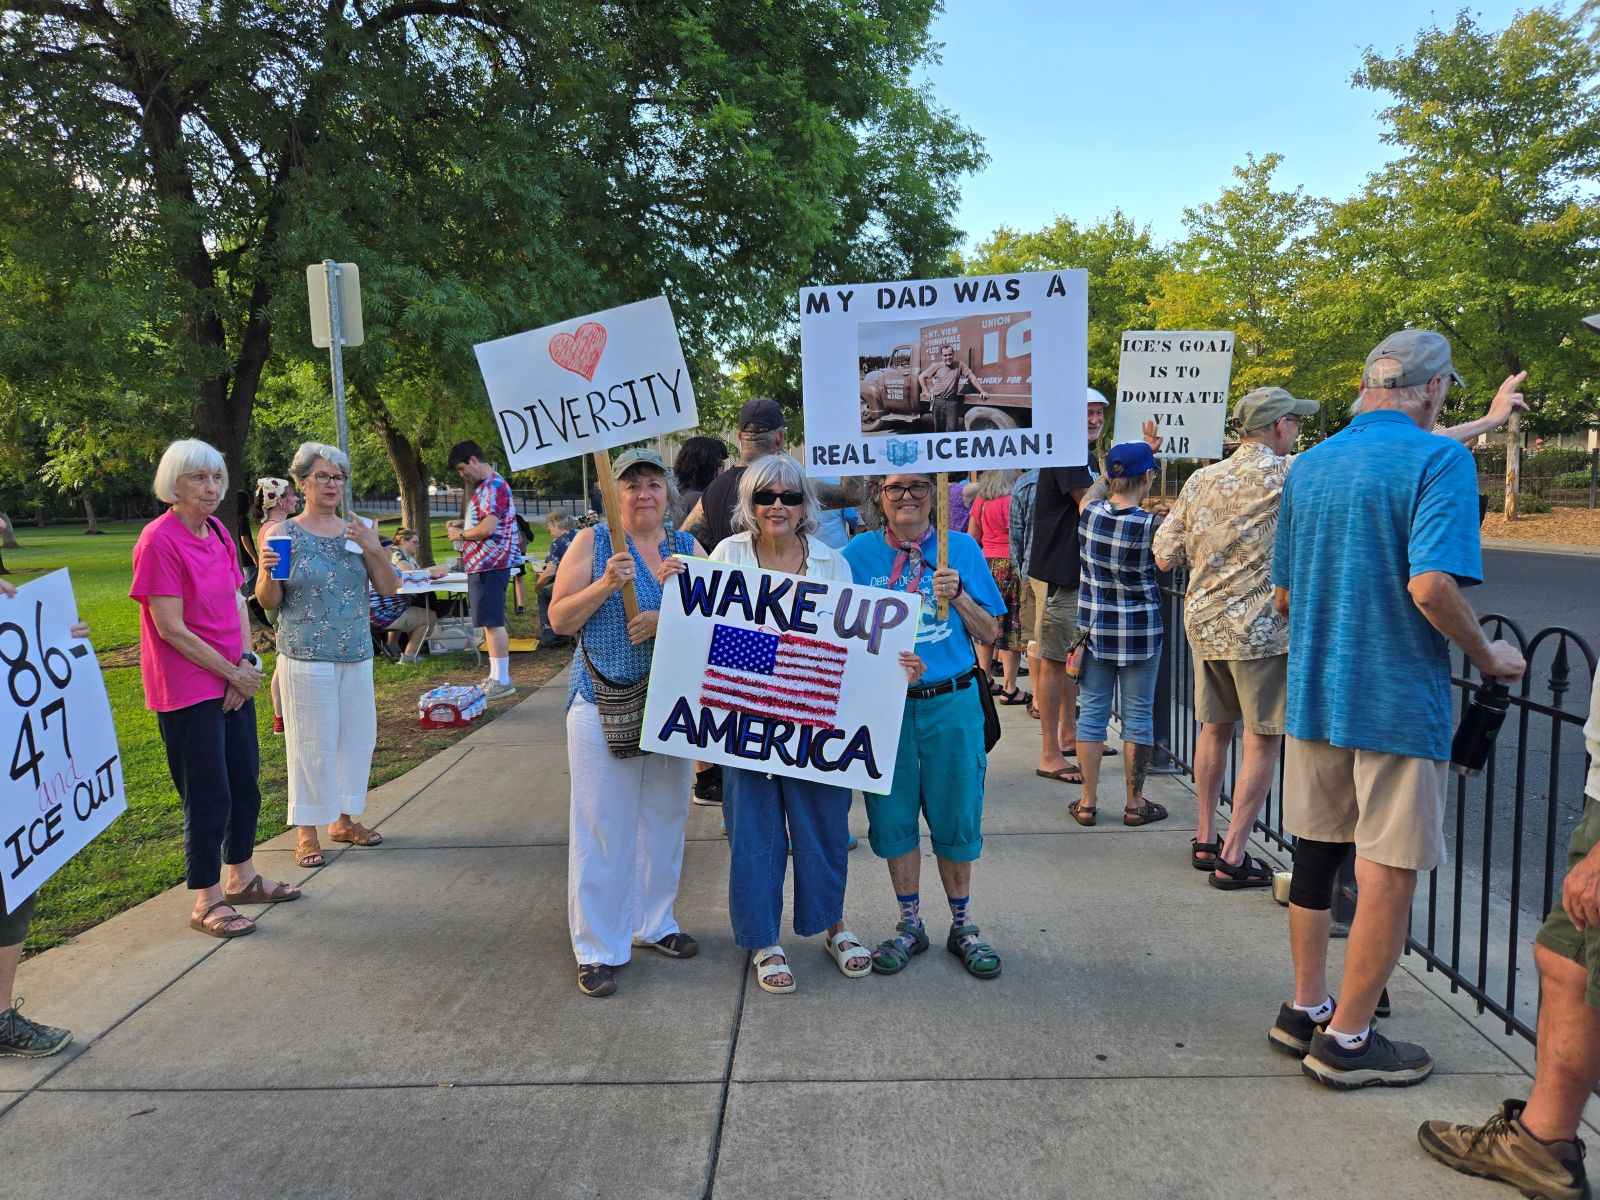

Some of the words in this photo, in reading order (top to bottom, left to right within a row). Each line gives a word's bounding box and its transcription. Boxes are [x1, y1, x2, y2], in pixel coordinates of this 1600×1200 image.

[806, 290, 854, 314] MY
[877, 285, 938, 309] DAD
[953, 278, 1020, 303] WAS
[1046, 274, 1067, 297] A
[941, 326, 959, 335] VIEW
[982, 315, 1011, 329] UNION
[928, 334, 961, 347] SUNNYVALE
[1122, 339, 1172, 353] ICE'S
[1179, 339, 1231, 353] GOAL
[1006, 376, 1021, 384] FOR
[1149, 365, 1168, 378] IS
[1175, 366, 1200, 378] TO
[1121, 390, 1224, 404] DOMINATE
[499, 368, 681, 455] DIVERSITY
[1153, 413, 1185, 426] VIA
[812, 443, 876, 466] REAL
[927, 433, 1054, 460] ICEMAN!
[678, 563, 828, 634] WAKE
[10, 697, 73, 790] 47
[658, 696, 883, 779] AMERICA
[39, 754, 84, 812] and
[4, 803, 64, 880] ICE
